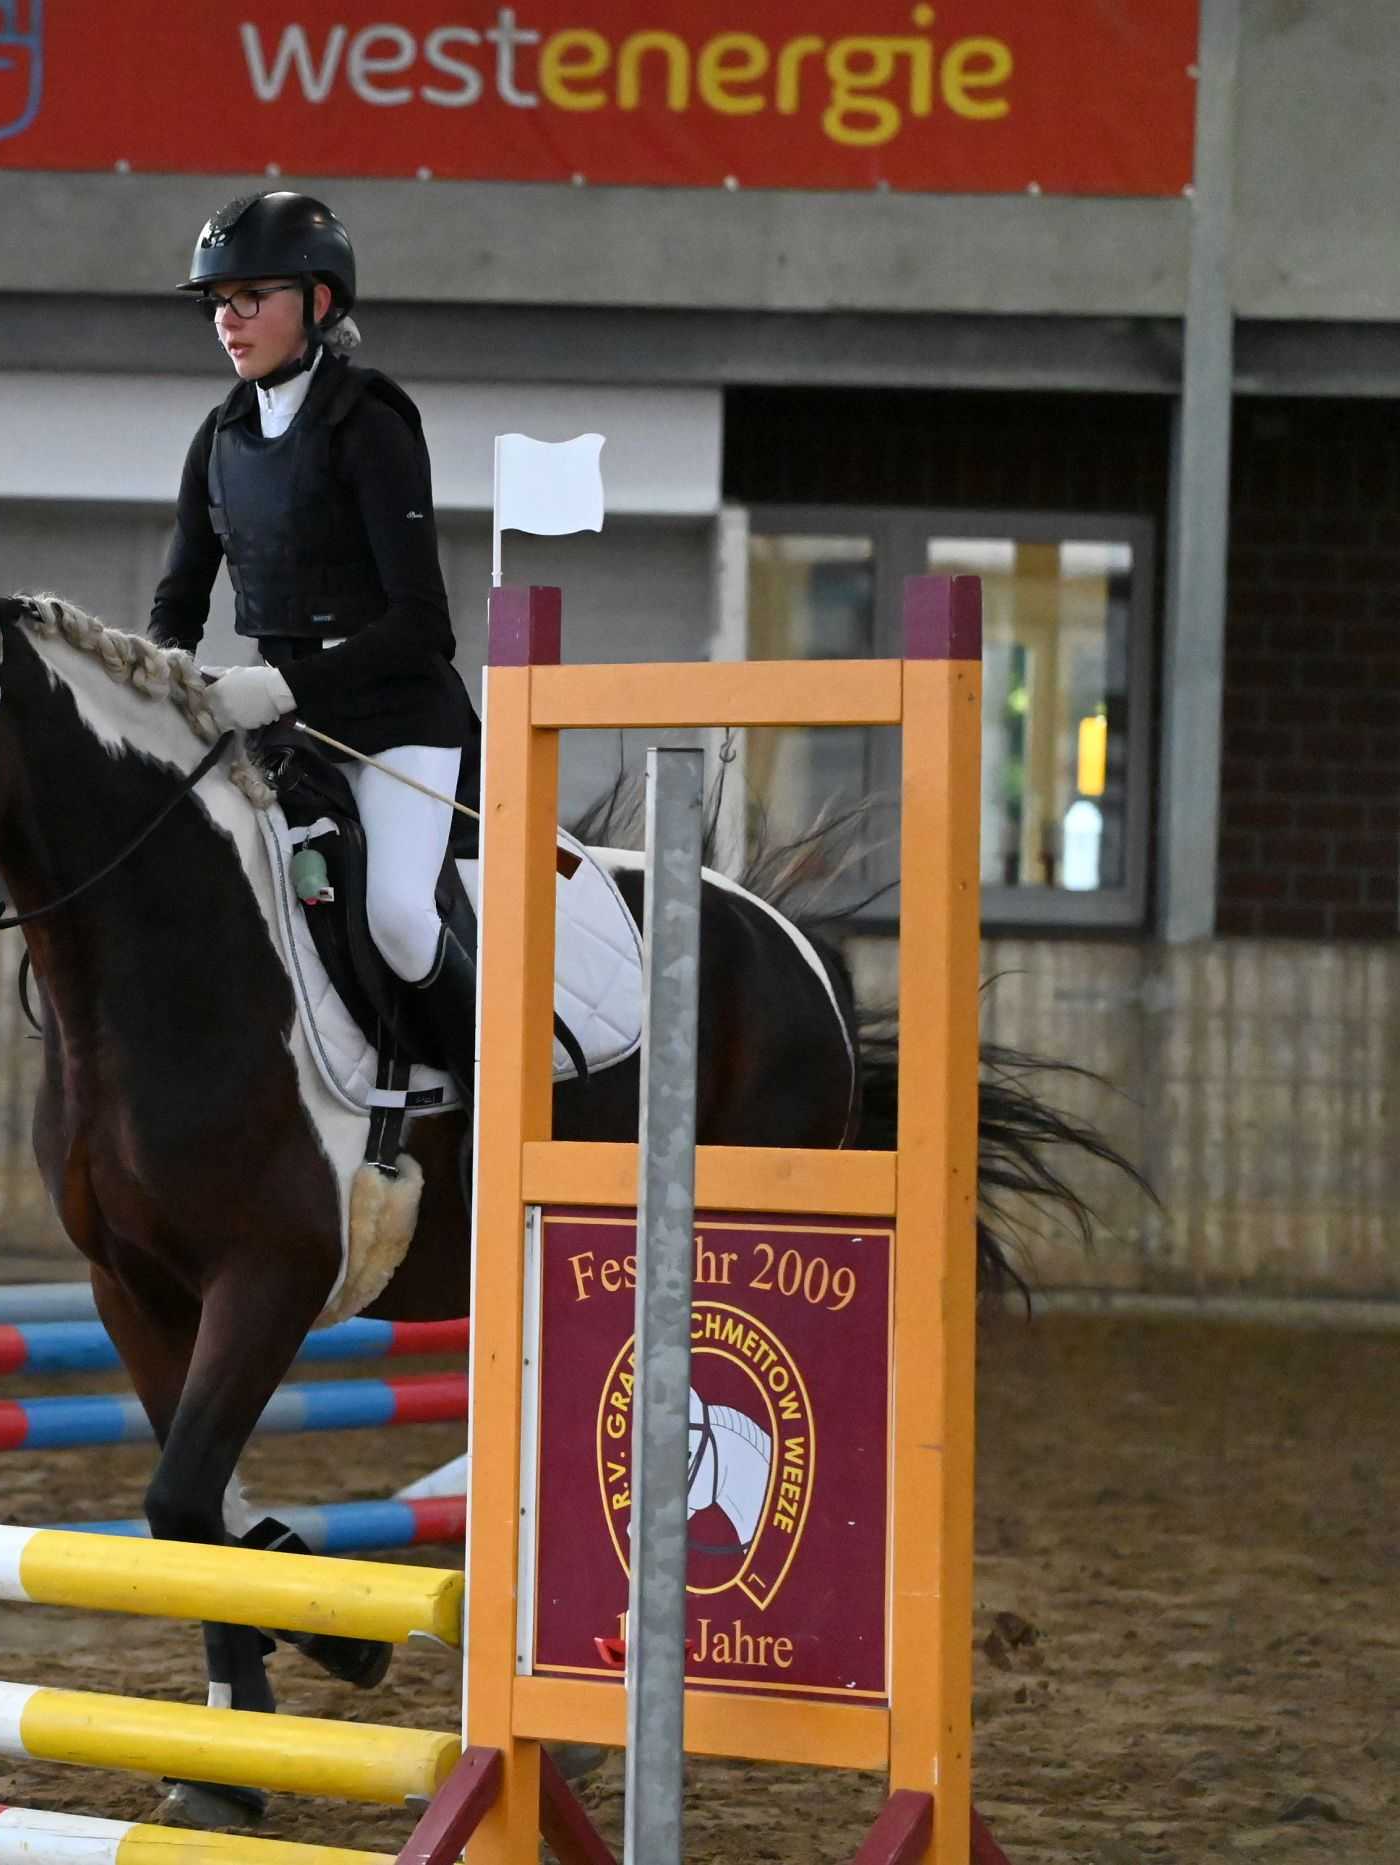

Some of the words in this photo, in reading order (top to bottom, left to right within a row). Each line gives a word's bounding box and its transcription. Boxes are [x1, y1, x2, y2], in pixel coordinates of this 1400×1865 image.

[240, 4, 1013, 147] westenergie
[567, 1234, 739, 1302] Feshr
[748, 1242, 857, 1311] 2009
[690, 1312, 802, 1421] CHMETTOW
[772, 1436, 806, 1535] WEEZE
[612, 1451, 632, 1511] R.V.
[692, 1618, 794, 1669] Jahre
